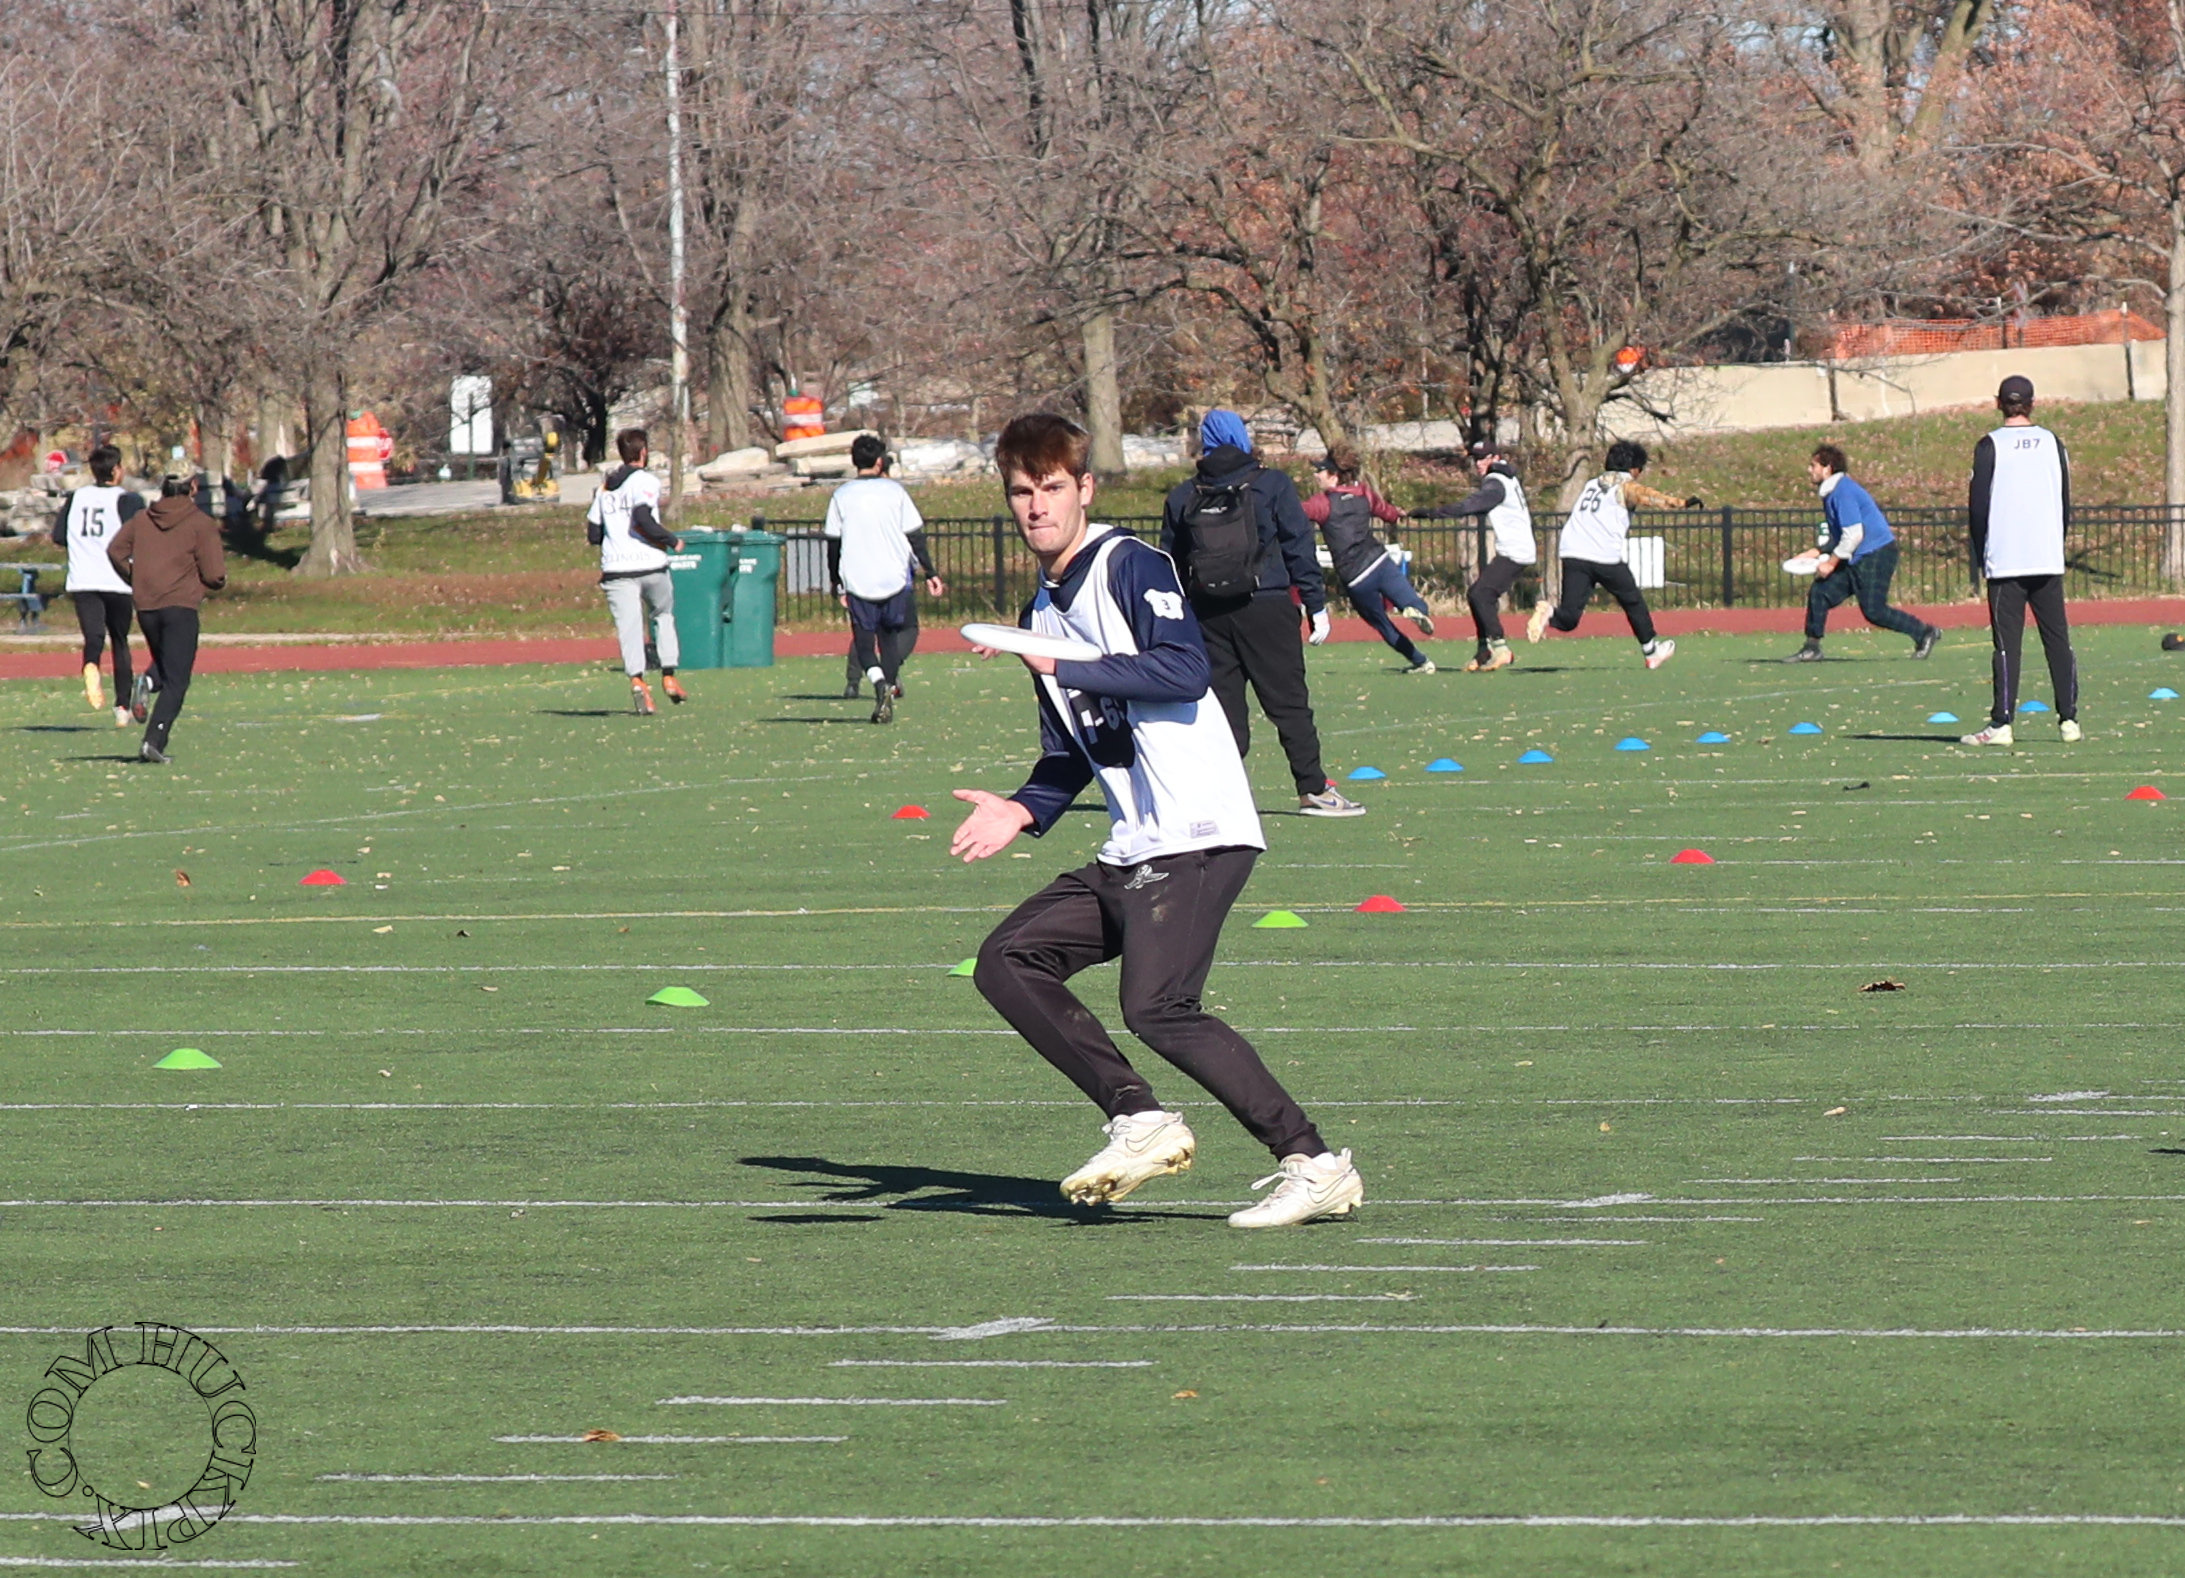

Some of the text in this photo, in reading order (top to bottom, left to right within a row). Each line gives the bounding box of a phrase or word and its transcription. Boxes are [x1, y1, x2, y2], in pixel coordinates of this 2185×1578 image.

[2013, 438, 2041, 450] JB7
[1578, 487, 1602, 513] 26
[80, 506, 105, 538] 15
[1160, 598, 1172, 611] 3
